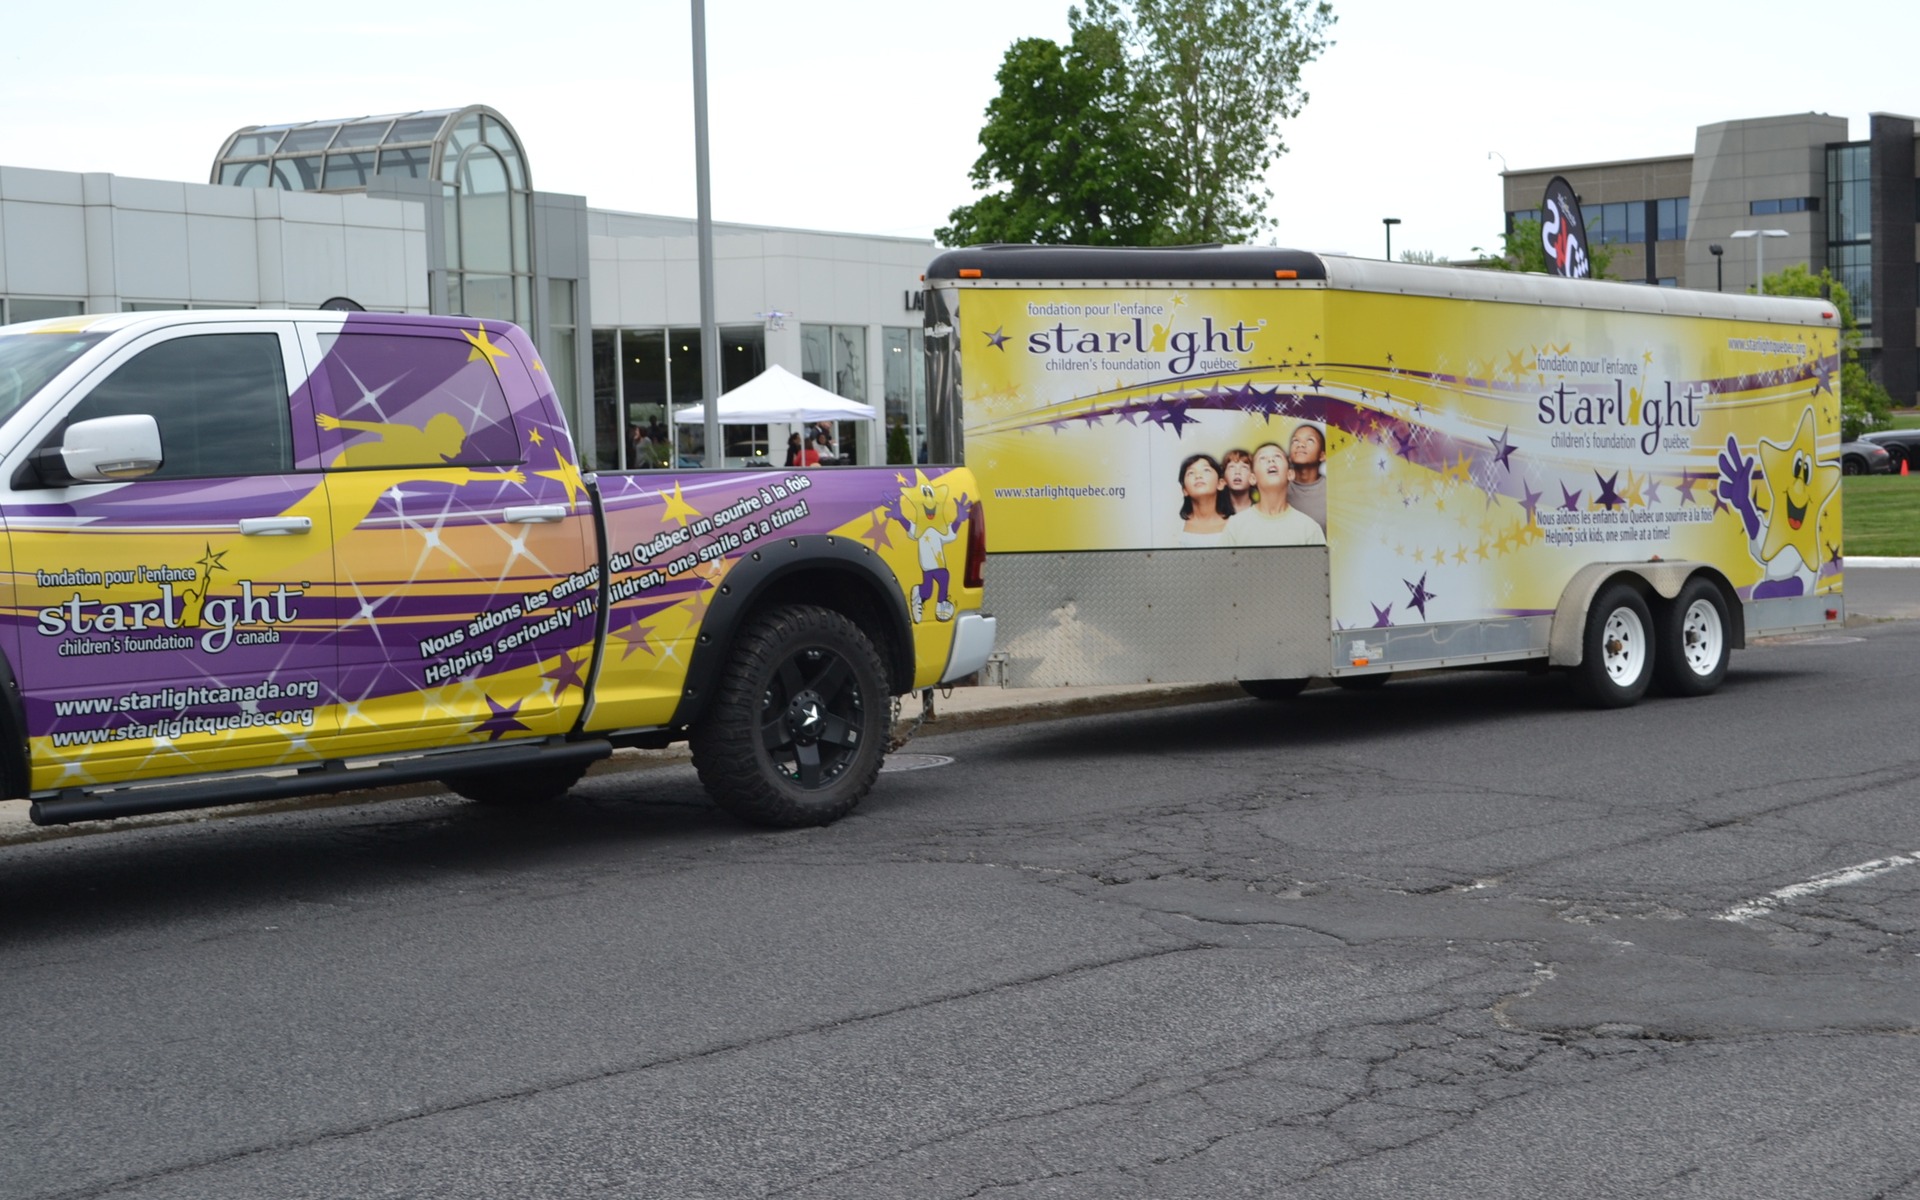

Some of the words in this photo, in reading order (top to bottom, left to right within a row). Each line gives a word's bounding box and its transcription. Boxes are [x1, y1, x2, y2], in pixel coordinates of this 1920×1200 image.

[1027, 303, 1080, 316] fondation
[1085, 303, 1109, 317] pour
[1113, 302, 1163, 315] l'enfance
[1028, 318, 1259, 374] starlight
[1045, 357, 1098, 370] children's
[1101, 357, 1161, 370] foundation
[1200, 357, 1238, 371] québec
[1537, 354, 1578, 373] fondation
[1580, 359, 1598, 376] pour
[1601, 359, 1637, 375] l'enfance
[1538, 379, 1703, 455] starlight
[1551, 433, 1590, 448] children's
[1592, 434, 1636, 449] foundation
[1663, 435, 1690, 451] québec
[994, 484, 1126, 499] www.starlightquebec.org
[1537, 511, 1555, 525] Nous
[1556, 510, 1580, 525] aidons
[1581, 510, 1591, 524] les
[1592, 509, 1618, 524] enfants
[1620, 509, 1628, 523] du
[1630, 508, 1654, 524] Québec
[1655, 511, 1664, 522] un
[1665, 508, 1687, 522] sourire
[1688, 508, 1693, 521] à
[1694, 507, 1700, 521] la
[1701, 507, 1712, 520] fois
[1545, 529, 1573, 546] Helping
[1574, 528, 1587, 542] sick
[1589, 527, 1605, 544] kids,
[1606, 530, 1619, 542] one
[1620, 526, 1638, 540] smile
[1639, 529, 1646, 540] at
[1647, 530, 1652, 540] a
[1653, 525, 1670, 540] time!
[36, 569, 101, 586] fondation
[105, 567, 134, 588] pour
[138, 564, 196, 583] l'enfance
[420, 628, 465, 658] Nous
[468, 604, 522, 638] aidons
[523, 594, 549, 612] les
[610, 554, 632, 573] du
[633, 526, 690, 563] Québec
[691, 518, 712, 537] un
[713, 499, 761, 527] sourire
[760, 490, 773, 505] à
[771, 484, 788, 500] la
[785, 474, 812, 494] fois
[424, 645, 494, 685] Helping
[497, 608, 572, 653] seriously
[576, 597, 593, 618] ill
[668, 554, 697, 575] one
[699, 533, 741, 561] smile
[741, 524, 760, 542] at
[759, 520, 772, 534] a
[770, 499, 810, 529] time!
[36, 581, 304, 653] starlight
[58, 636, 121, 656] children's
[124, 635, 194, 652] foundation
[236, 629, 280, 645] canada
[54, 680, 319, 716] www.starlightcanada.org
[52, 708, 314, 748] www.starlightquebec.org
